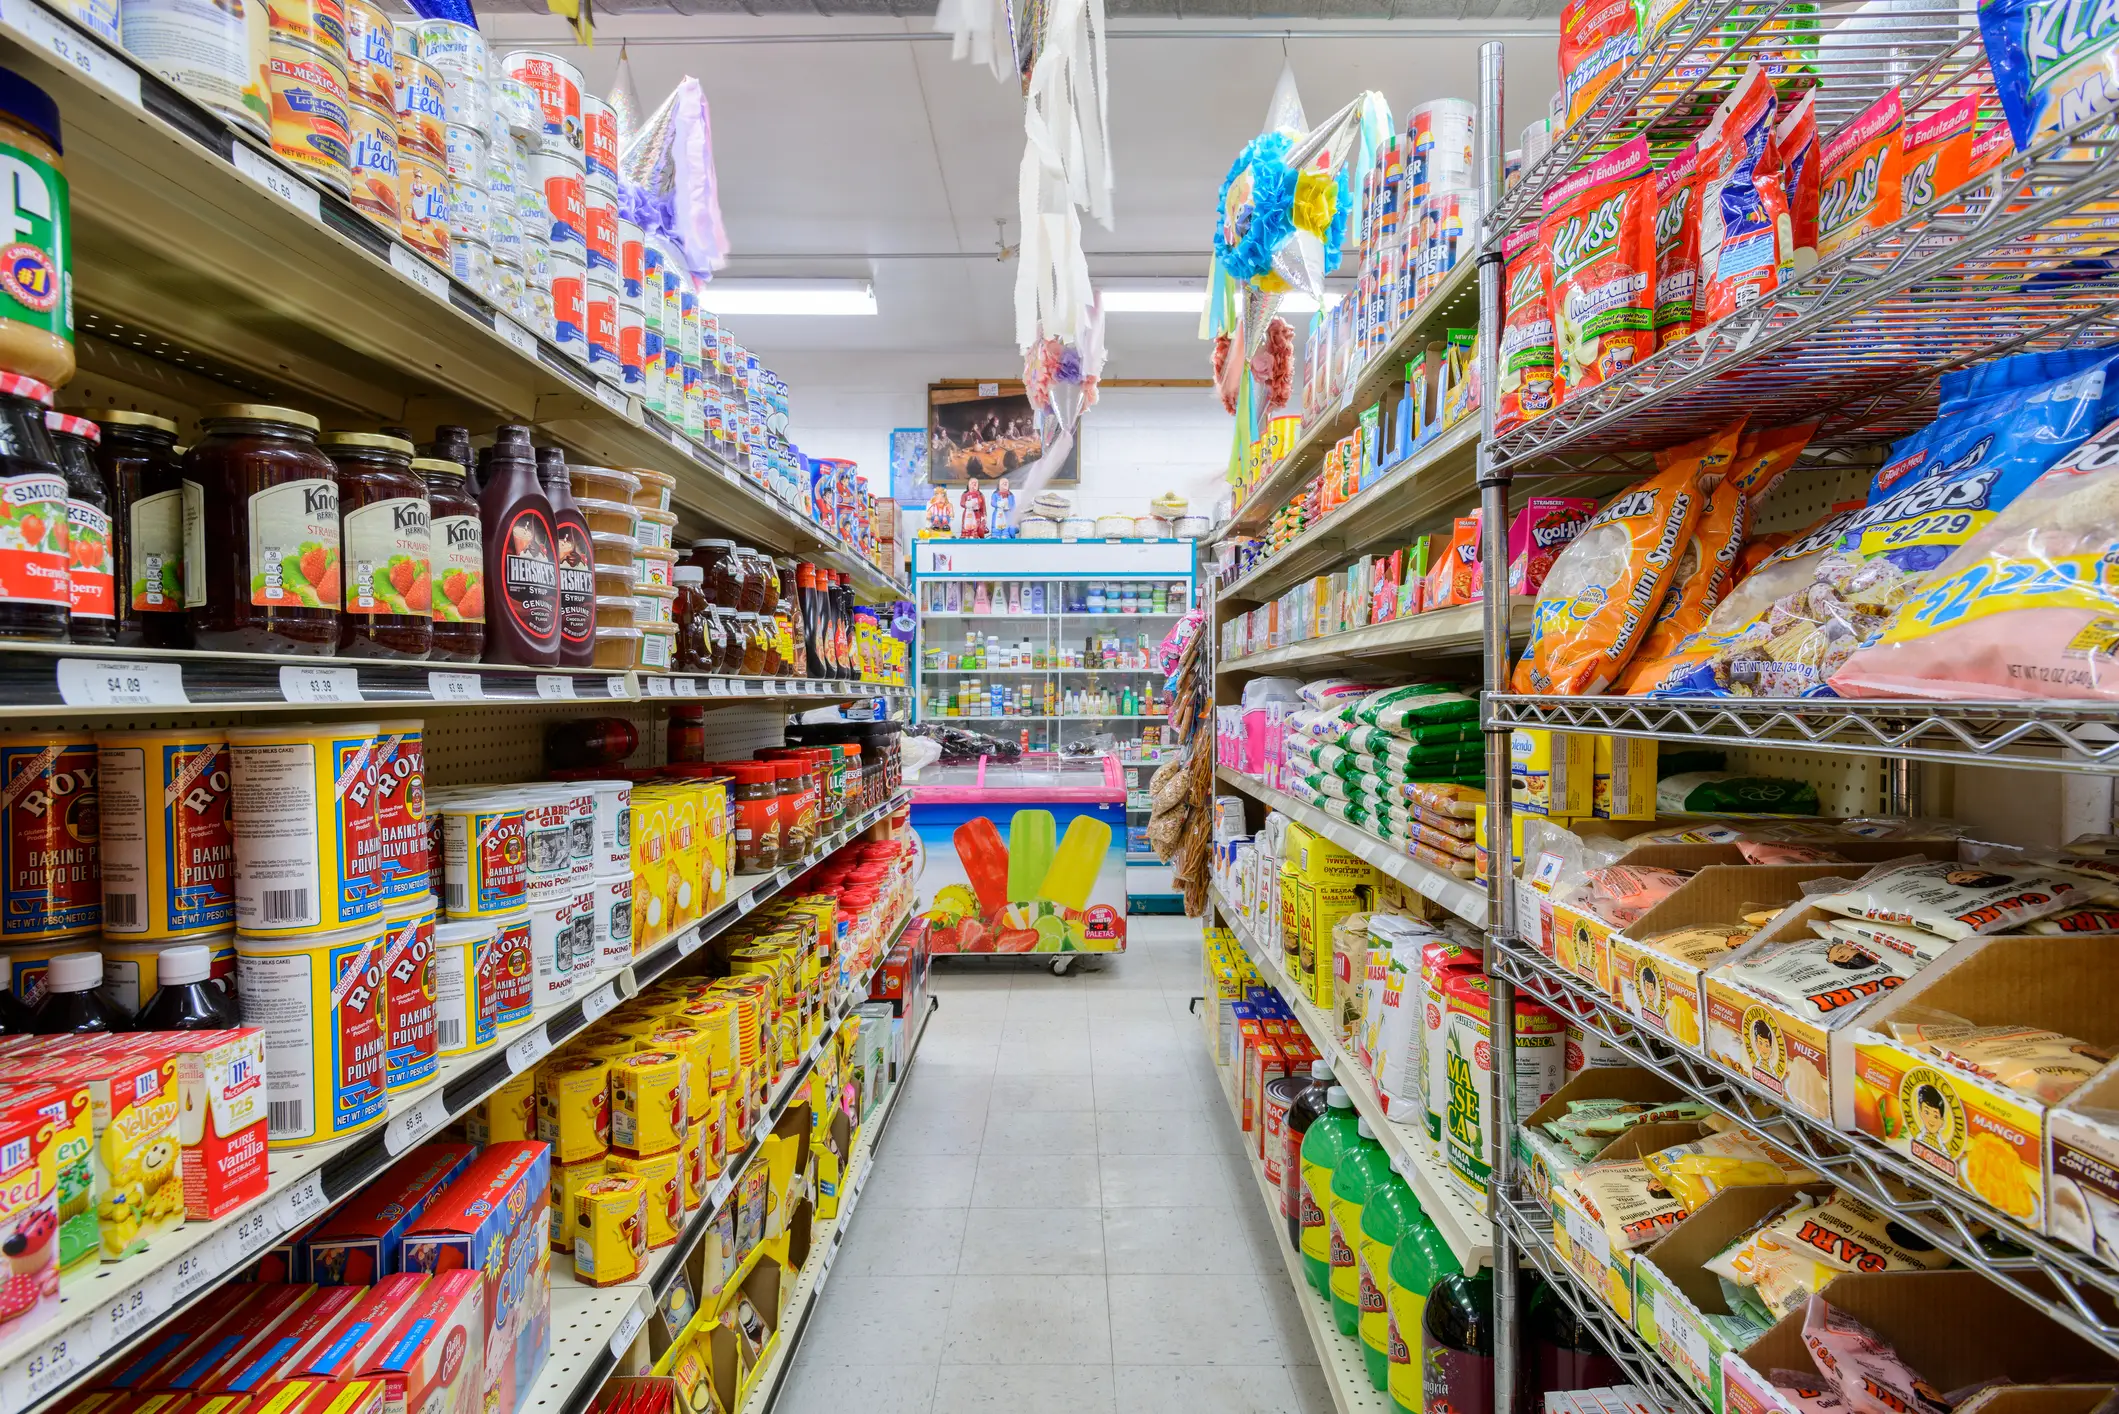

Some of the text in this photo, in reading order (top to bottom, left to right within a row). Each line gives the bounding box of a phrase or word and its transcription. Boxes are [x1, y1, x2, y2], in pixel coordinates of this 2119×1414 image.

[373, 28, 386, 49] La
[53, 37, 92, 73] $2.89
[417, 80, 431, 98] La
[295, 96, 320, 108] Leche
[1820, 101, 1897, 170] Sweetened Endulzado
[1914, 108, 1970, 143] Endulzado
[366, 133, 382, 153] La
[1548, 151, 1642, 205] Sweetened Endulzado
[433, 187, 444, 205] La
[1552, 192, 1628, 271] KLASS
[17, 267, 46, 293] #1
[1570, 272, 1648, 320] Manzana
[1716, 491, 1747, 568] Spooners
[1868, 525, 1895, 533] only
[510, 557, 556, 586] HERSHEY'S
[1603, 491, 1692, 661] Frosted Mini Spooners
[1733, 661, 1783, 673] NET WT 12 OZ
[2007, 664, 2022, 678] NET
[2024, 666, 2037, 679] WT
[2040, 667, 2050, 681] 12
[107, 677, 141, 692] $4.09
[310, 680, 332, 693] $3.39
[540, 815, 566, 828] GIRL
[382, 825, 417, 842] BAKING
[29, 848, 84, 868] BAKING
[19, 865, 88, 886] POLVO DE
[6, 919, 22, 929] NET
[22, 917, 36, 927] WT
[66, 912, 87, 922] NETO
[171, 915, 188, 926] NET
[188, 913, 201, 924] WT
[1367, 965, 1387, 981] MASA
[1666, 981, 1697, 1001] ROMPOPE
[400, 1008, 431, 1028] BAKING
[1710, 1008, 1737, 1025] CON LECHE
[1713, 1003, 1734, 1016] PREPARE
[393, 1025, 425, 1046] POLVO
[1793, 1041, 1821, 1062] NUEZ
[1932, 1076, 1940, 1087] Y
[116, 1099, 177, 1142] Yellow
[336, 1112, 362, 1126] NET WT
[1983, 1100, 2013, 1120] Mango
[1972, 1113, 2025, 1147] MANGO
[227, 1130, 256, 1153] PURE
[2071, 1134, 2116, 1160] Gelatina
[217, 1140, 264, 1173] Vanilla
[1451, 1147, 1471, 1167] MASA
[2066, 1150, 2113, 1178] PREPARE
[227, 1157, 257, 1178] EXTRACT
[2058, 1156, 2119, 1191] CON LECHE
[291, 1184, 314, 1208] $2.39
[464, 1198, 492, 1218] Joy
[238, 1214, 264, 1241] $2.99
[1818, 1211, 1854, 1233] Gelatina
[1857, 1231, 1894, 1255] Dessert
[177, 1259, 191, 1278] 49
[110, 1289, 144, 1324] $3.29
[27, 1340, 67, 1379] $3.29
